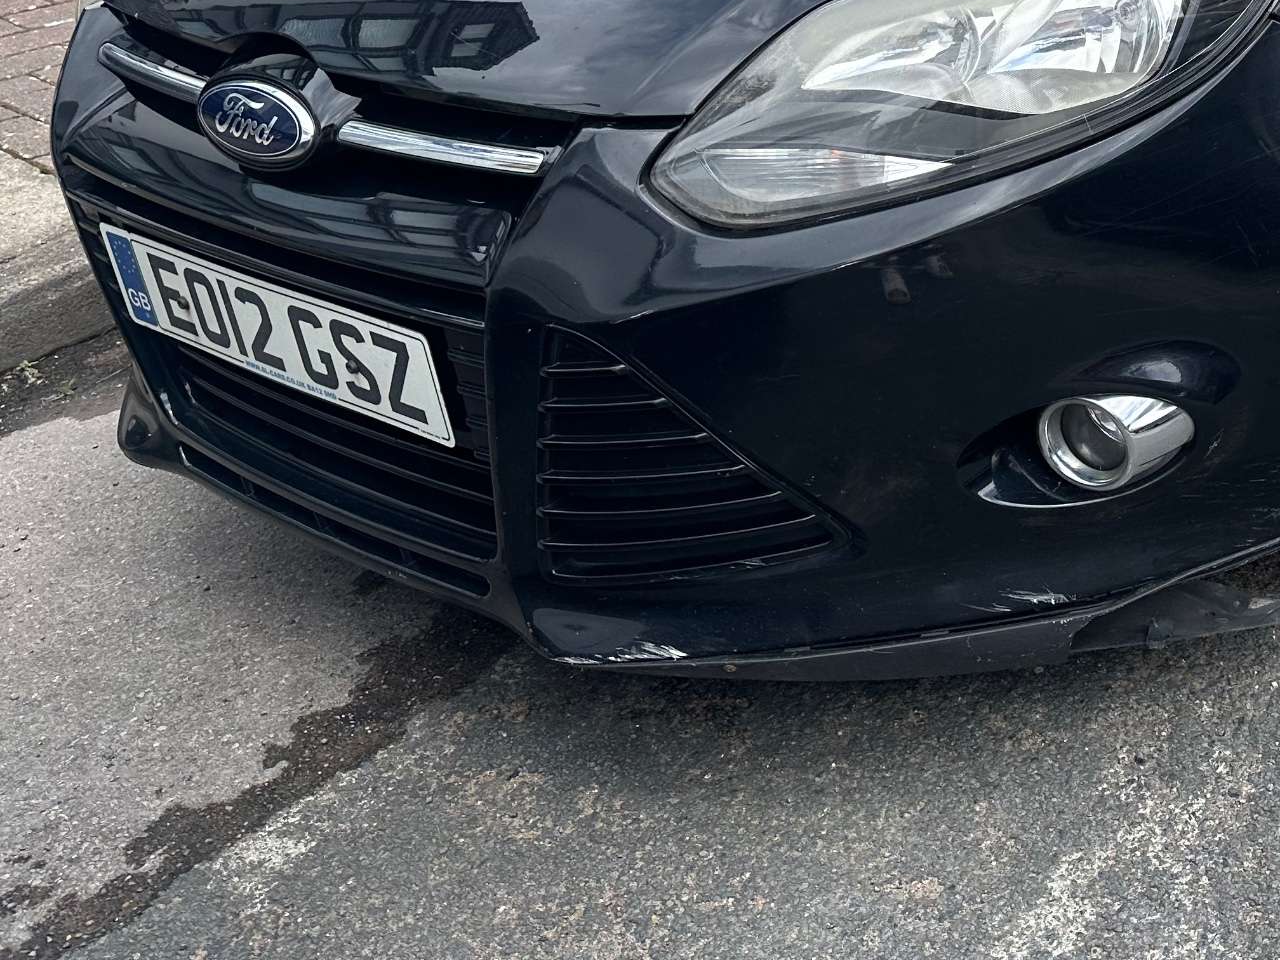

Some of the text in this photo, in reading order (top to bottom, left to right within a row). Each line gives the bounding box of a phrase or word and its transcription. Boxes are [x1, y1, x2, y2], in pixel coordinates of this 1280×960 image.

[214, 92, 276, 147] Ford
[127, 288, 152, 311] GB
[145, 251, 429, 425] EO12 GSZ
